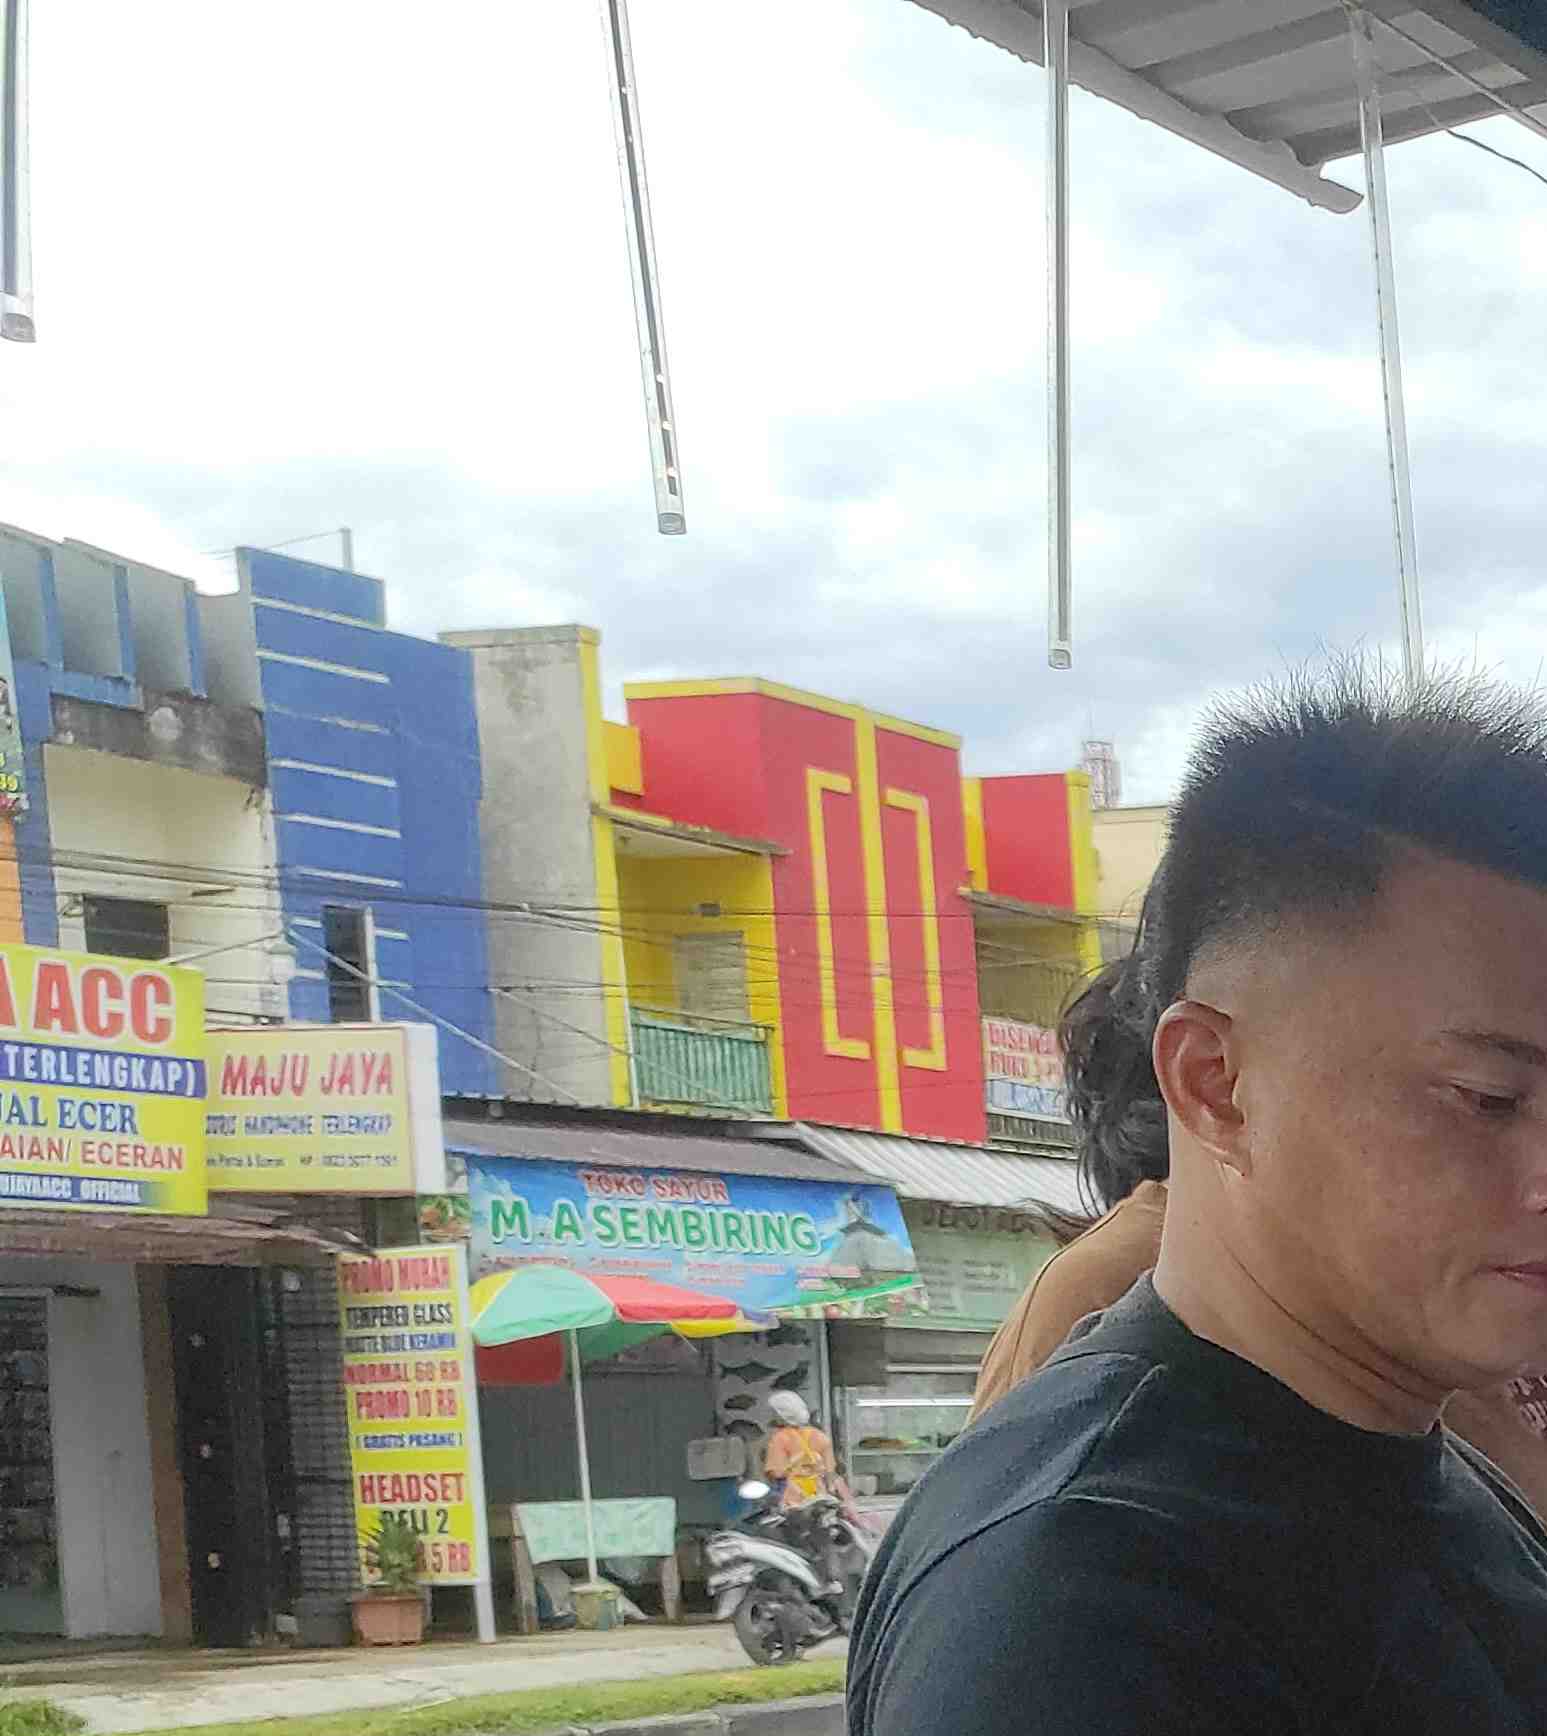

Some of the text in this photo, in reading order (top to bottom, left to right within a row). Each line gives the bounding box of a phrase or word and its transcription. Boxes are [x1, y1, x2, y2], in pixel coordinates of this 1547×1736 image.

[32, 961, 172, 1044] ACC
[3, 1044, 197, 1097] TERLENGKAP)
[221, 1051, 394, 1097] MAJU JAYA
[0, 1090, 139, 1136] AL ECER
[80, 1140, 184, 1170] ECERAN
[583, 1172, 727, 1201] TOKO SAYUR
[591, 1203, 818, 1251] SEMBIRING
[413, 1302, 453, 1325] GLASS
[359, 1472, 465, 1504] HEADSET
[435, 1508, 449, 1535] 2
